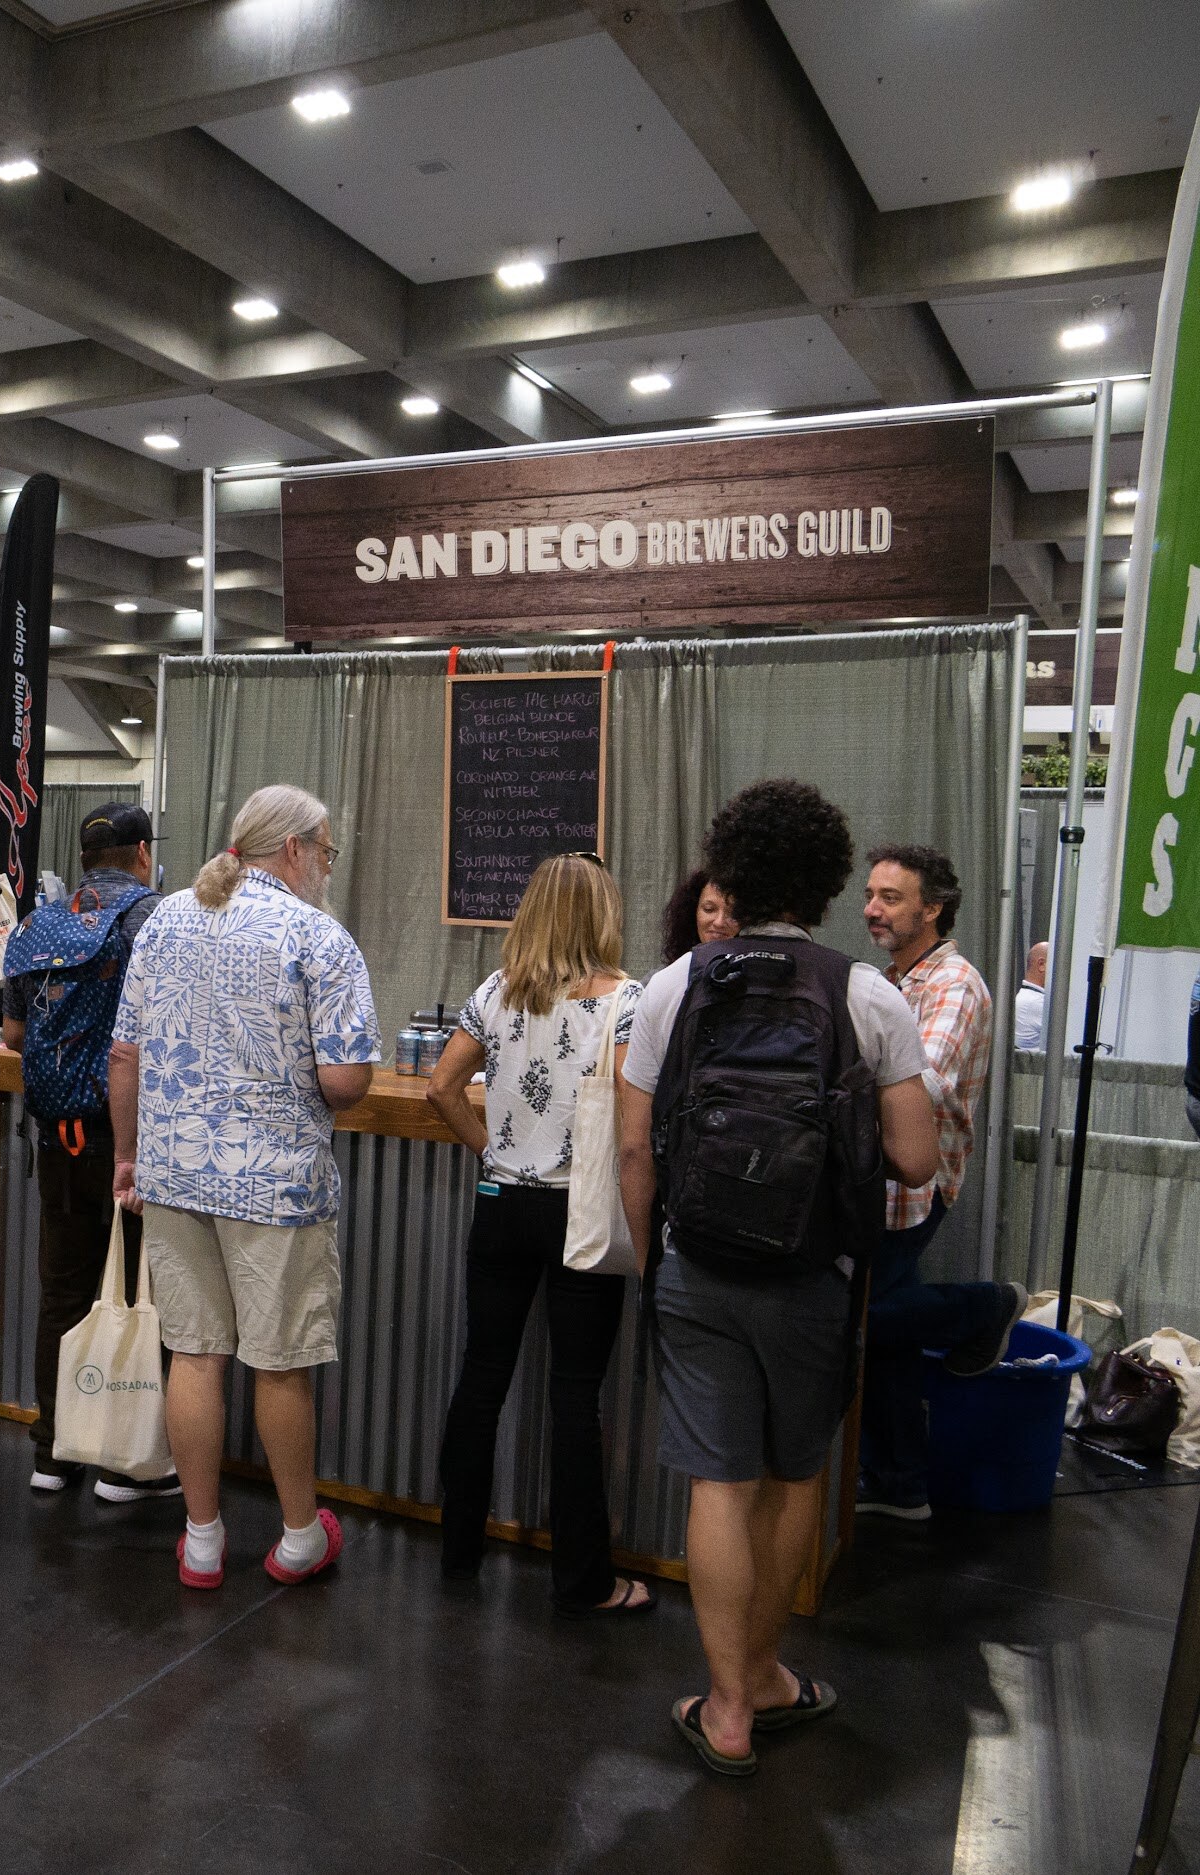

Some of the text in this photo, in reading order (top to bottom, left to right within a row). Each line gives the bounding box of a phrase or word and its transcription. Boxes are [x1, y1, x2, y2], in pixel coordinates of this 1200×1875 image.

[355, 506, 892, 584] SAN DIEGO BREWERS GUILD
[12, 600, 27, 749] Brewing Supply
[525, 692, 549, 708] THE
[474, 712, 576, 726] BELGIAN BLONDE
[482, 746, 559, 762] NZ PILSNER
[457, 770, 519, 784] CORONADO
[530, 770, 576, 782] ORANGE
[484, 786, 541, 798] WITBIER
[464, 822, 596, 838] TABULA RASA PORTER
[453, 888, 500, 907] MOTHER
[466, 905, 494, 916] SAY
